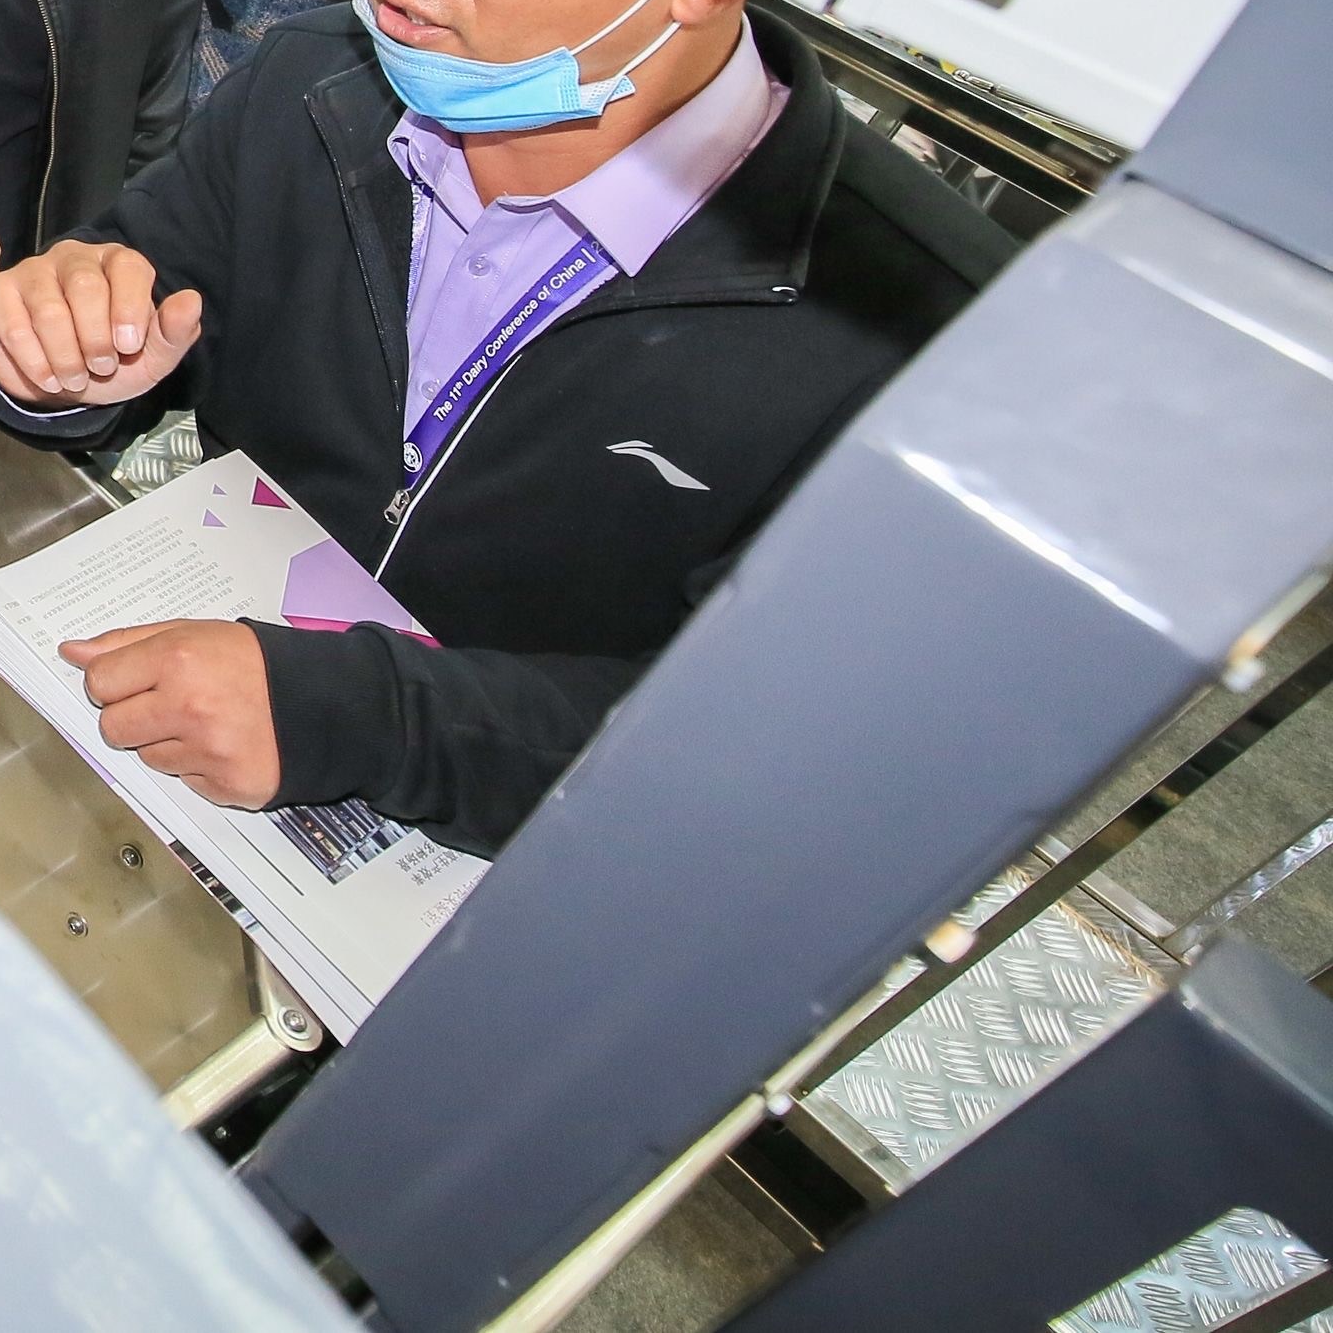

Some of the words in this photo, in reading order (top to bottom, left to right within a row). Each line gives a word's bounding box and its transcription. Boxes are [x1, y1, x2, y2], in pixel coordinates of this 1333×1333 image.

[434, 401, 453, 422] The
[449, 381, 464, 402] 11th
[462, 355, 489, 386] Dairy
[485, 298, 539, 358] Conference
[538, 285, 551, 302] of
[549, 255, 587, 290] China
[396, 840, 441, 872] 多种场景
[411, 849, 465, 886] 高生产效率
